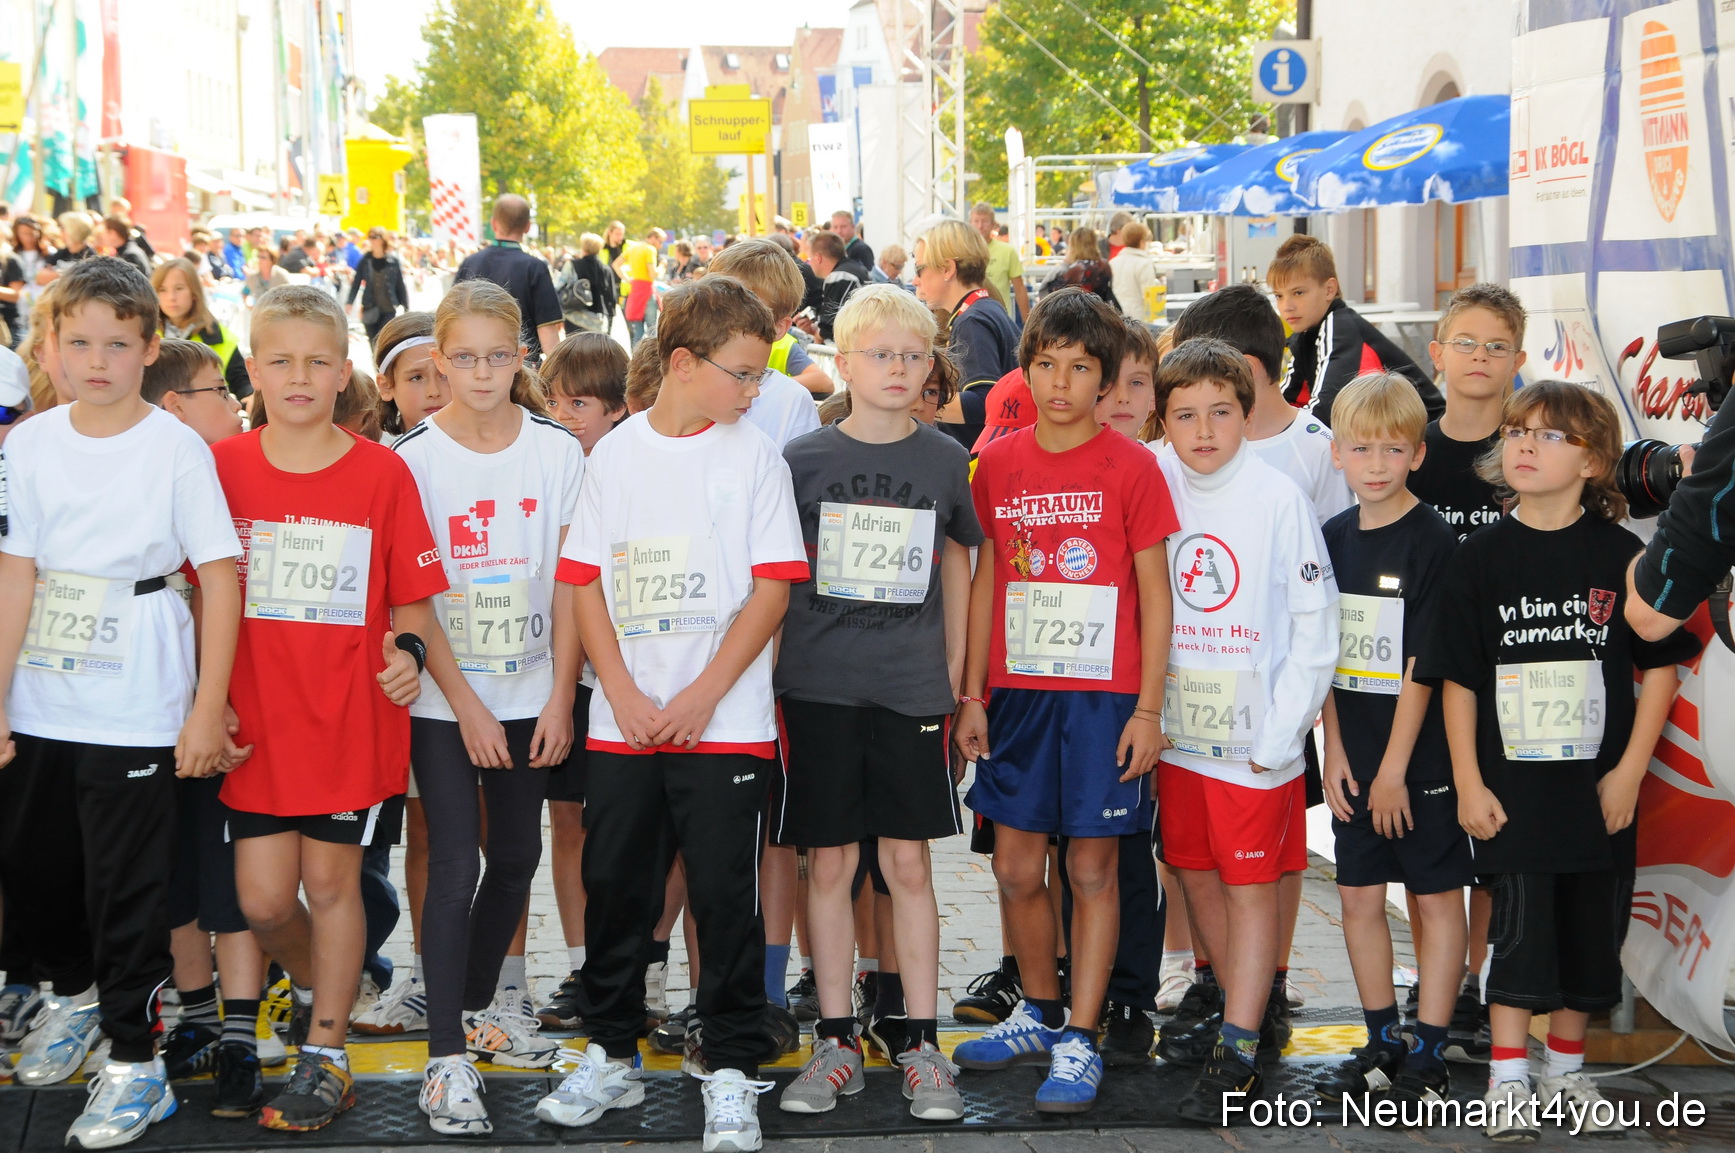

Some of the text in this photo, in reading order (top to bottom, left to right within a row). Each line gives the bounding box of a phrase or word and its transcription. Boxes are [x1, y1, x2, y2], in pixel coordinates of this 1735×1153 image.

[694, 114, 765, 127] Schnupper-
[718, 130, 741, 141] lauf
[1551, 137, 1589, 169] BÖGL
[323, 187, 339, 206] A
[796, 210, 804, 221] B
[1023, 494, 1101, 514] TRAUM
[995, 506, 1023, 519] Ein
[1023, 511, 1101, 526] wird wahr
[1470, 505, 1500, 525] ein
[852, 512, 901, 533] Adrian
[282, 530, 324, 551] Henri
[822, 538, 829, 551] K
[453, 542, 487, 557] DKMS
[633, 547, 671, 565] Anton
[1067, 540, 1095, 558] BAYERN
[253, 557, 260, 571] K
[459, 557, 529, 571] JEDER EINZELNE ZÄHLT
[852, 542, 923, 572] 7246
[282, 561, 358, 592] 7092
[1059, 563, 1094, 579] MÜNCHEN
[48, 579, 85, 601] Petar
[616, 579, 621, 592] K
[635, 572, 707, 603] 7252
[887, 588, 925, 597] PFLEIDERER
[475, 591, 511, 609] Anna
[809, 598, 838, 614] THE
[1033, 590, 1062, 608] Paul
[1521, 596, 1557, 619] bin
[1562, 594, 1588, 616] ein
[318, 608, 363, 619] PFLEIDERER
[671, 616, 716, 626] PFLEIDERER
[47, 610, 119, 643] 7235
[477, 613, 544, 644] 7170
[1009, 617, 1015, 629] K
[1172, 624, 1196, 635] FEN
[1202, 627, 1223, 637] MIT
[1033, 619, 1105, 647] 7237
[1178, 642, 1200, 651] Heck
[1208, 645, 1219, 653] Dr.
[1221, 645, 1251, 654] Rösch
[76, 658, 123, 671] PFLEIDERER
[518, 651, 547, 666] PFLEIDERER
[1066, 662, 1110, 673] PFLEIDERER
[1183, 675, 1222, 694] Jonas
[1359, 676, 1400, 688] PFLEIDERER
[1529, 670, 1575, 689] Niklas
[1502, 701, 1509, 715] K
[1532, 699, 1599, 727] 7245
[1187, 702, 1251, 730] 7241
[127, 768, 154, 778] JAKO
[331, 812, 358, 821] adidas
[1113, 808, 1128, 817] JAKO
[1245, 850, 1265, 858] JAKO
